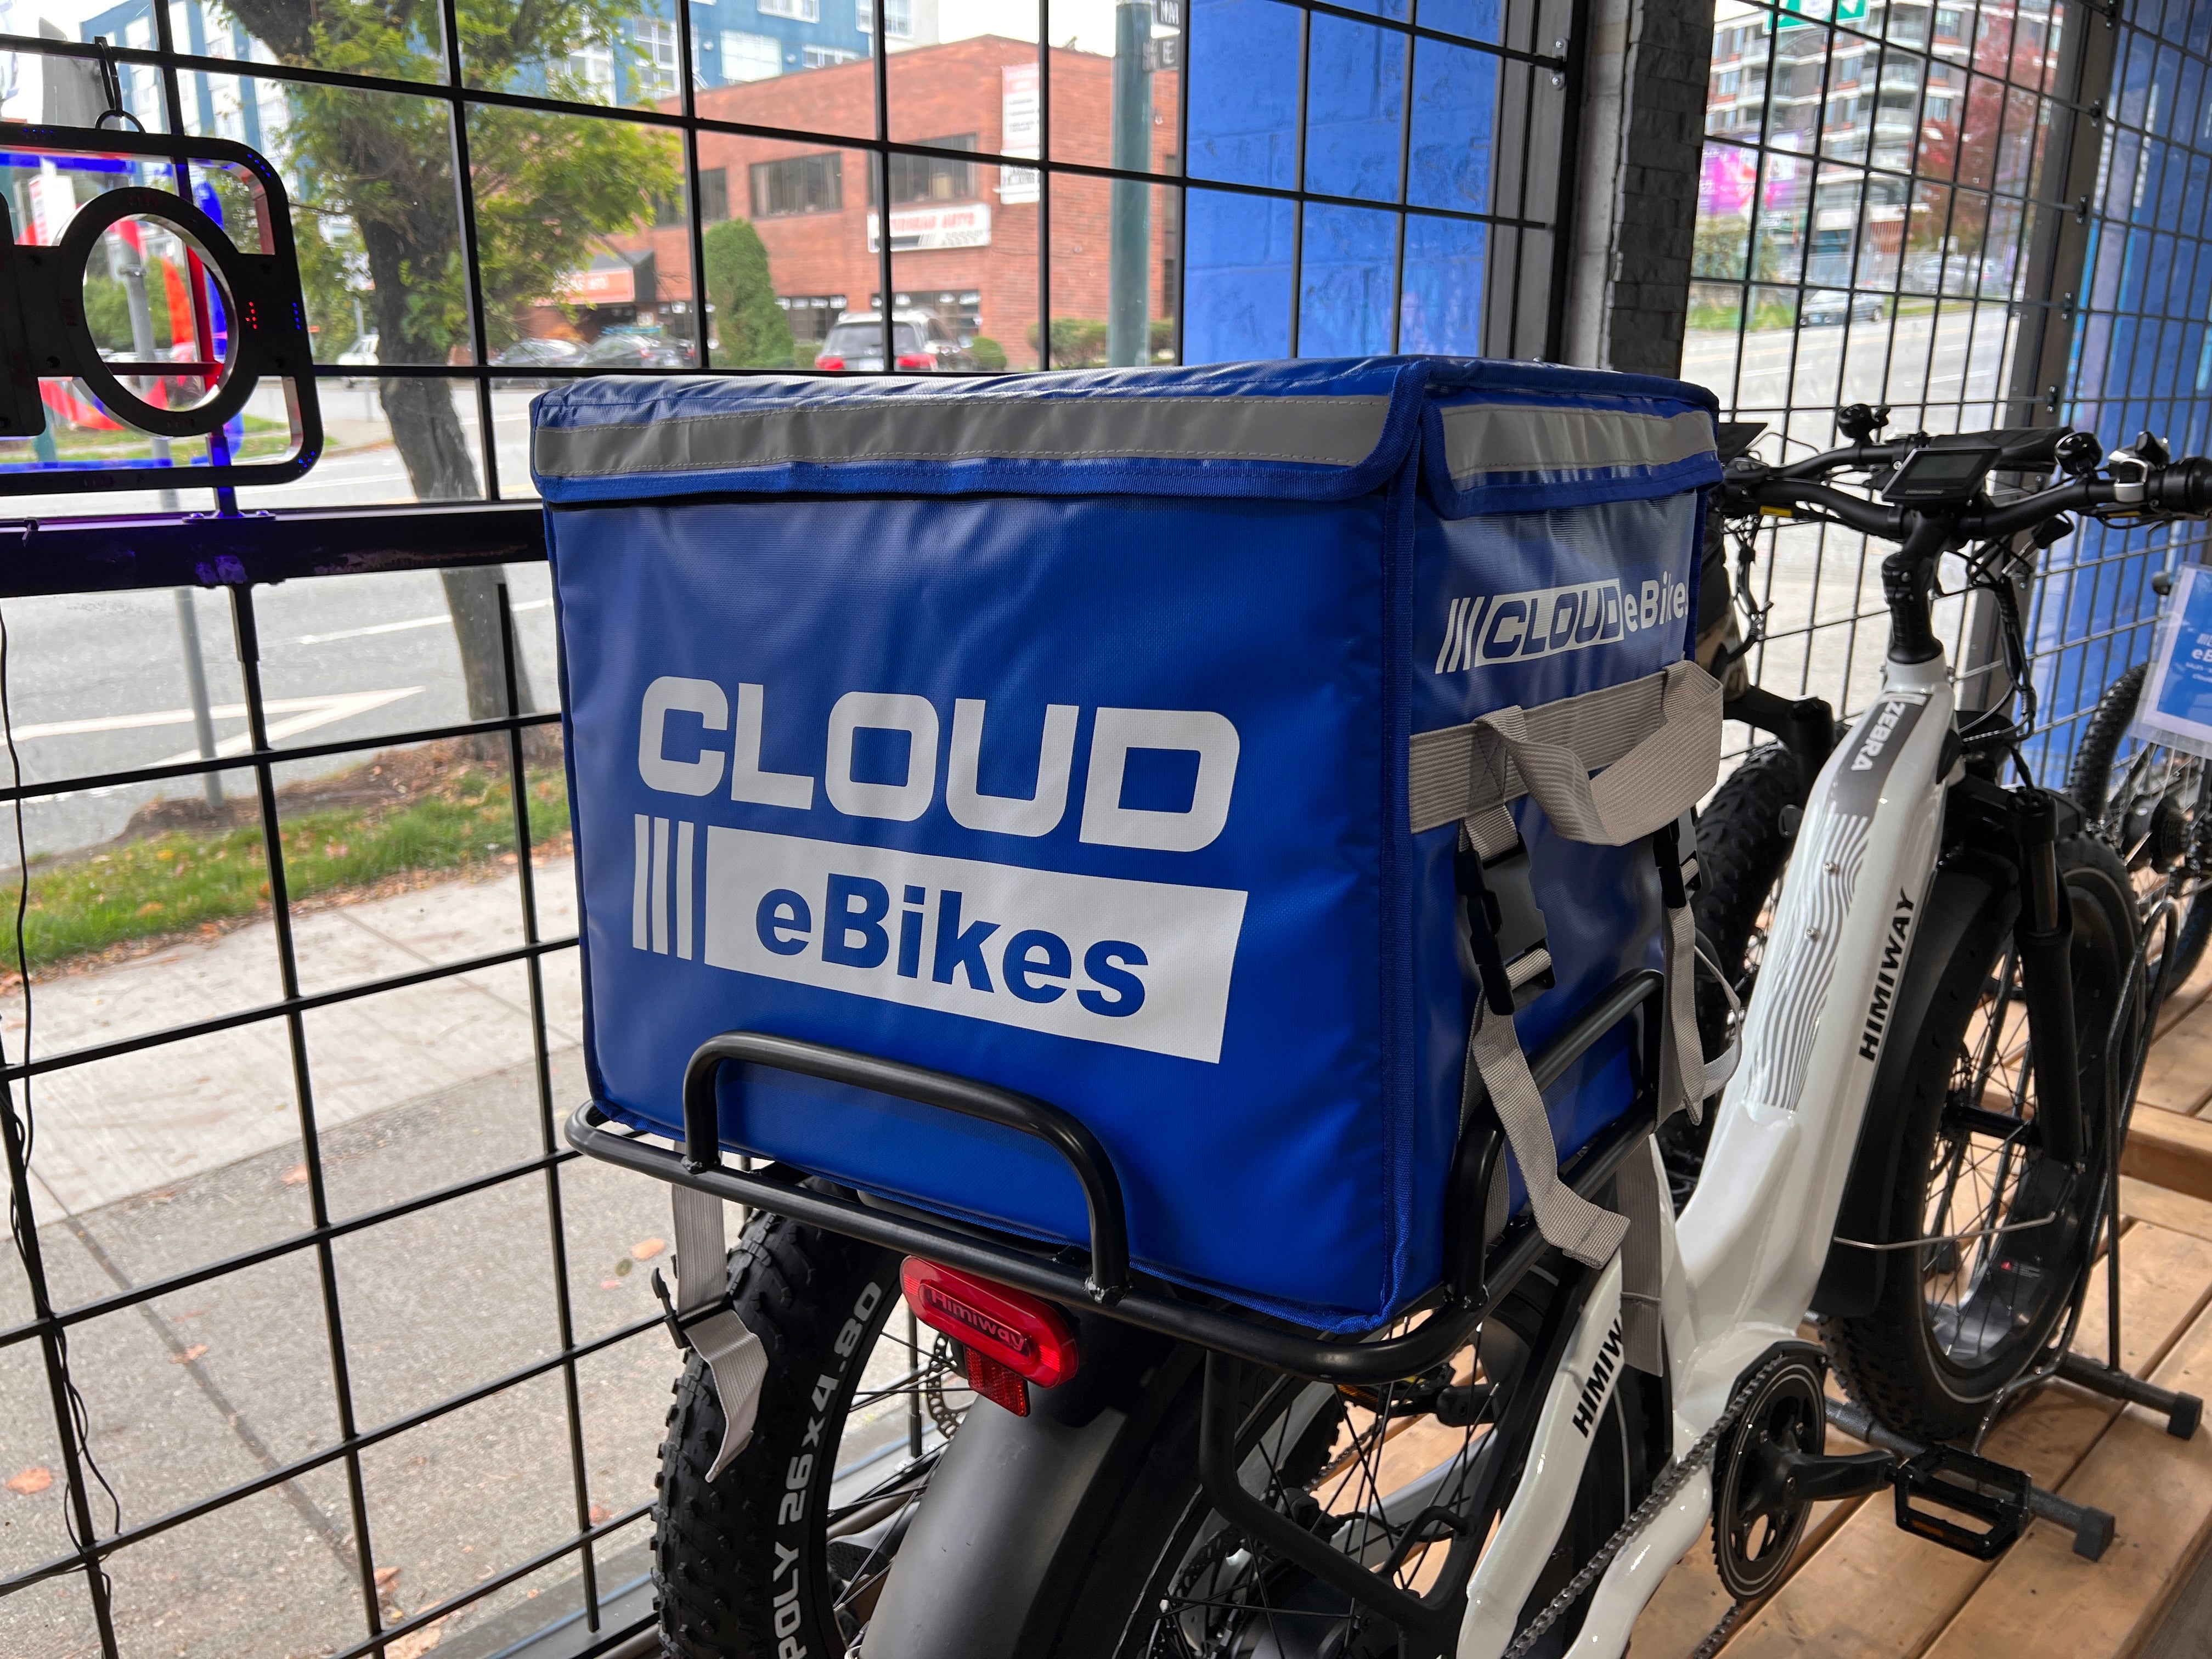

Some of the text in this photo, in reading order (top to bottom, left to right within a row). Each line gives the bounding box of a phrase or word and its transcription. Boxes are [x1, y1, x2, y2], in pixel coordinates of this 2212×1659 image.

[1160, 1, 1179, 25] MAI
[1482, 586, 1621, 659] CLOUD
[638, 675, 1240, 853] CLOUD
[1851, 702, 1906, 771] ZEBRA
[755, 872, 1149, 1018] eBikes
[1858, 885, 1914, 1063] HIMIWAY
[931, 1289, 1024, 1352] Himiway
[1572, 1318, 1622, 1438] HIMIW
